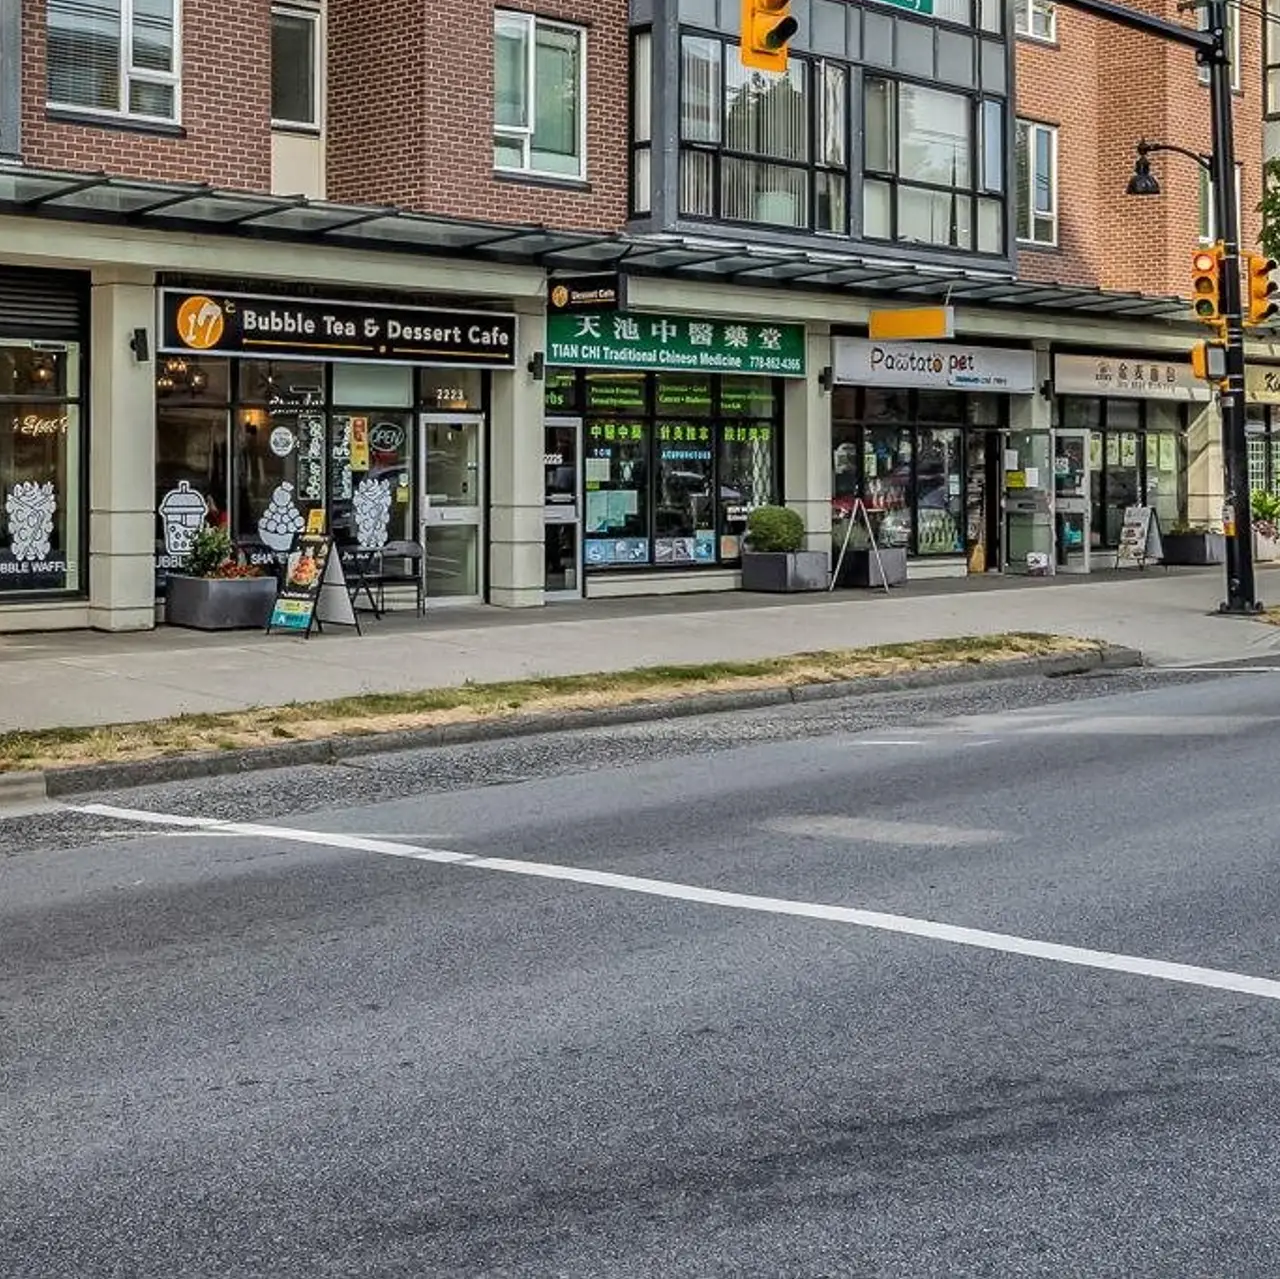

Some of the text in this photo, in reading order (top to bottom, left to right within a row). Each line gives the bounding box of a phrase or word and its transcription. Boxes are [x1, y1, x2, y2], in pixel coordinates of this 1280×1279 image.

[242, 309, 509, 346] Bubble Tea & Dessert Cafe
[573, 315, 782, 351] 天池中醫藥堂
[551, 343, 579, 359] TIAN
[581, 345, 601, 360] CHI
[602, 346, 657, 363] Traditional
[658, 349, 698, 367] Chinese
[699, 352, 743, 369] Medicine
[871, 347, 975, 375] Pawtato pet
[31, 560, 77, 573] WAFFLE
